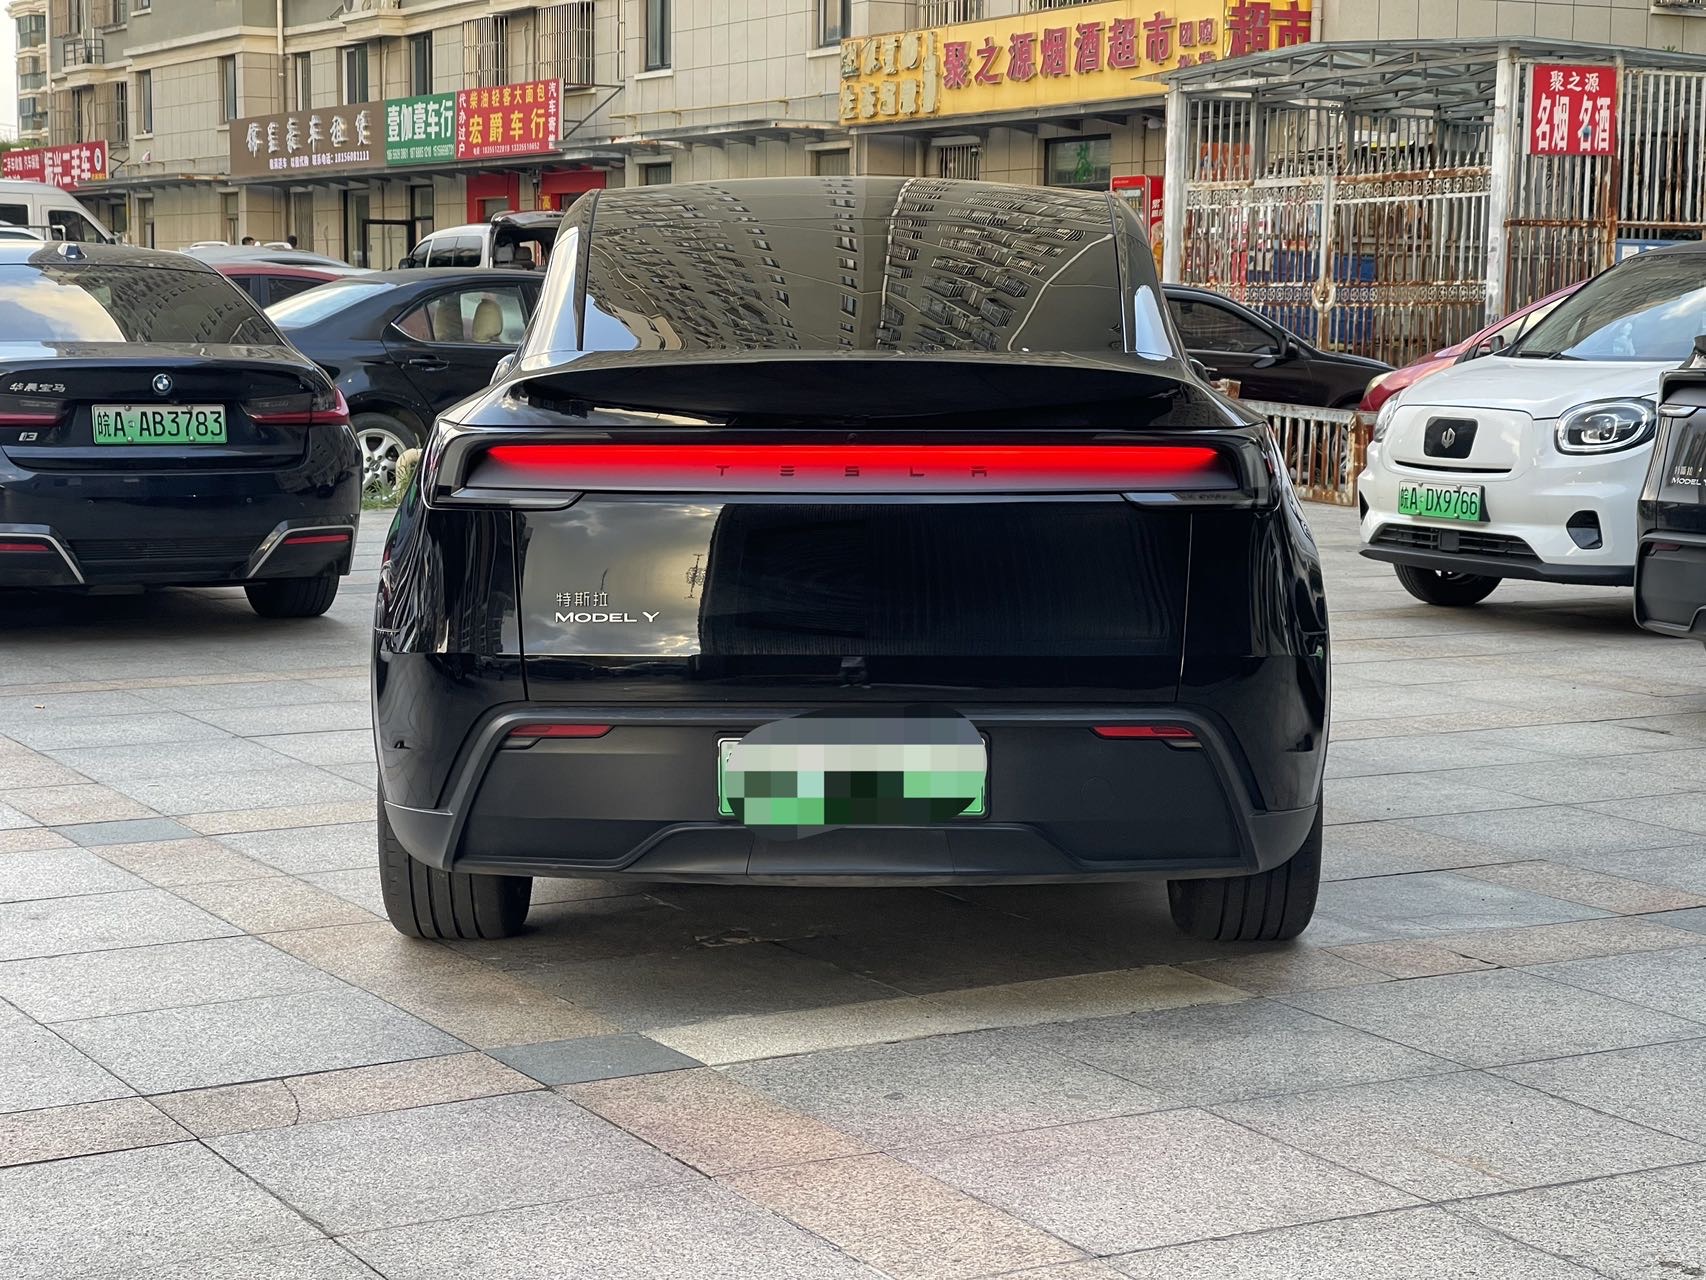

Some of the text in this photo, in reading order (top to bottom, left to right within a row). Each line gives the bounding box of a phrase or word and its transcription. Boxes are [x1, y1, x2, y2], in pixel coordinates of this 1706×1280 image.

[1225, 0, 1310, 58] 超市
[943, 11, 1175, 89] 聚之源烟酒超市
[469, 82, 546, 109] 柴油轻客大面包
[1549, 70, 1599, 93] 聚之源
[387, 99, 453, 142] 壹伽壹车行
[457, 93, 467, 157] 代办过户
[469, 107, 546, 145] 宏爵车行
[1536, 92, 1611, 152] 名烟 名酒
[44, 146, 91, 187] 振兴二手车
[9, 382, 66, 393] 华晨宝马
[716, 465, 988, 477] TESLA
[1671, 477, 1702, 486] MODEL
[556, 591, 608, 607] 特斯拉
[555, 611, 660, 623] MODEL Y
